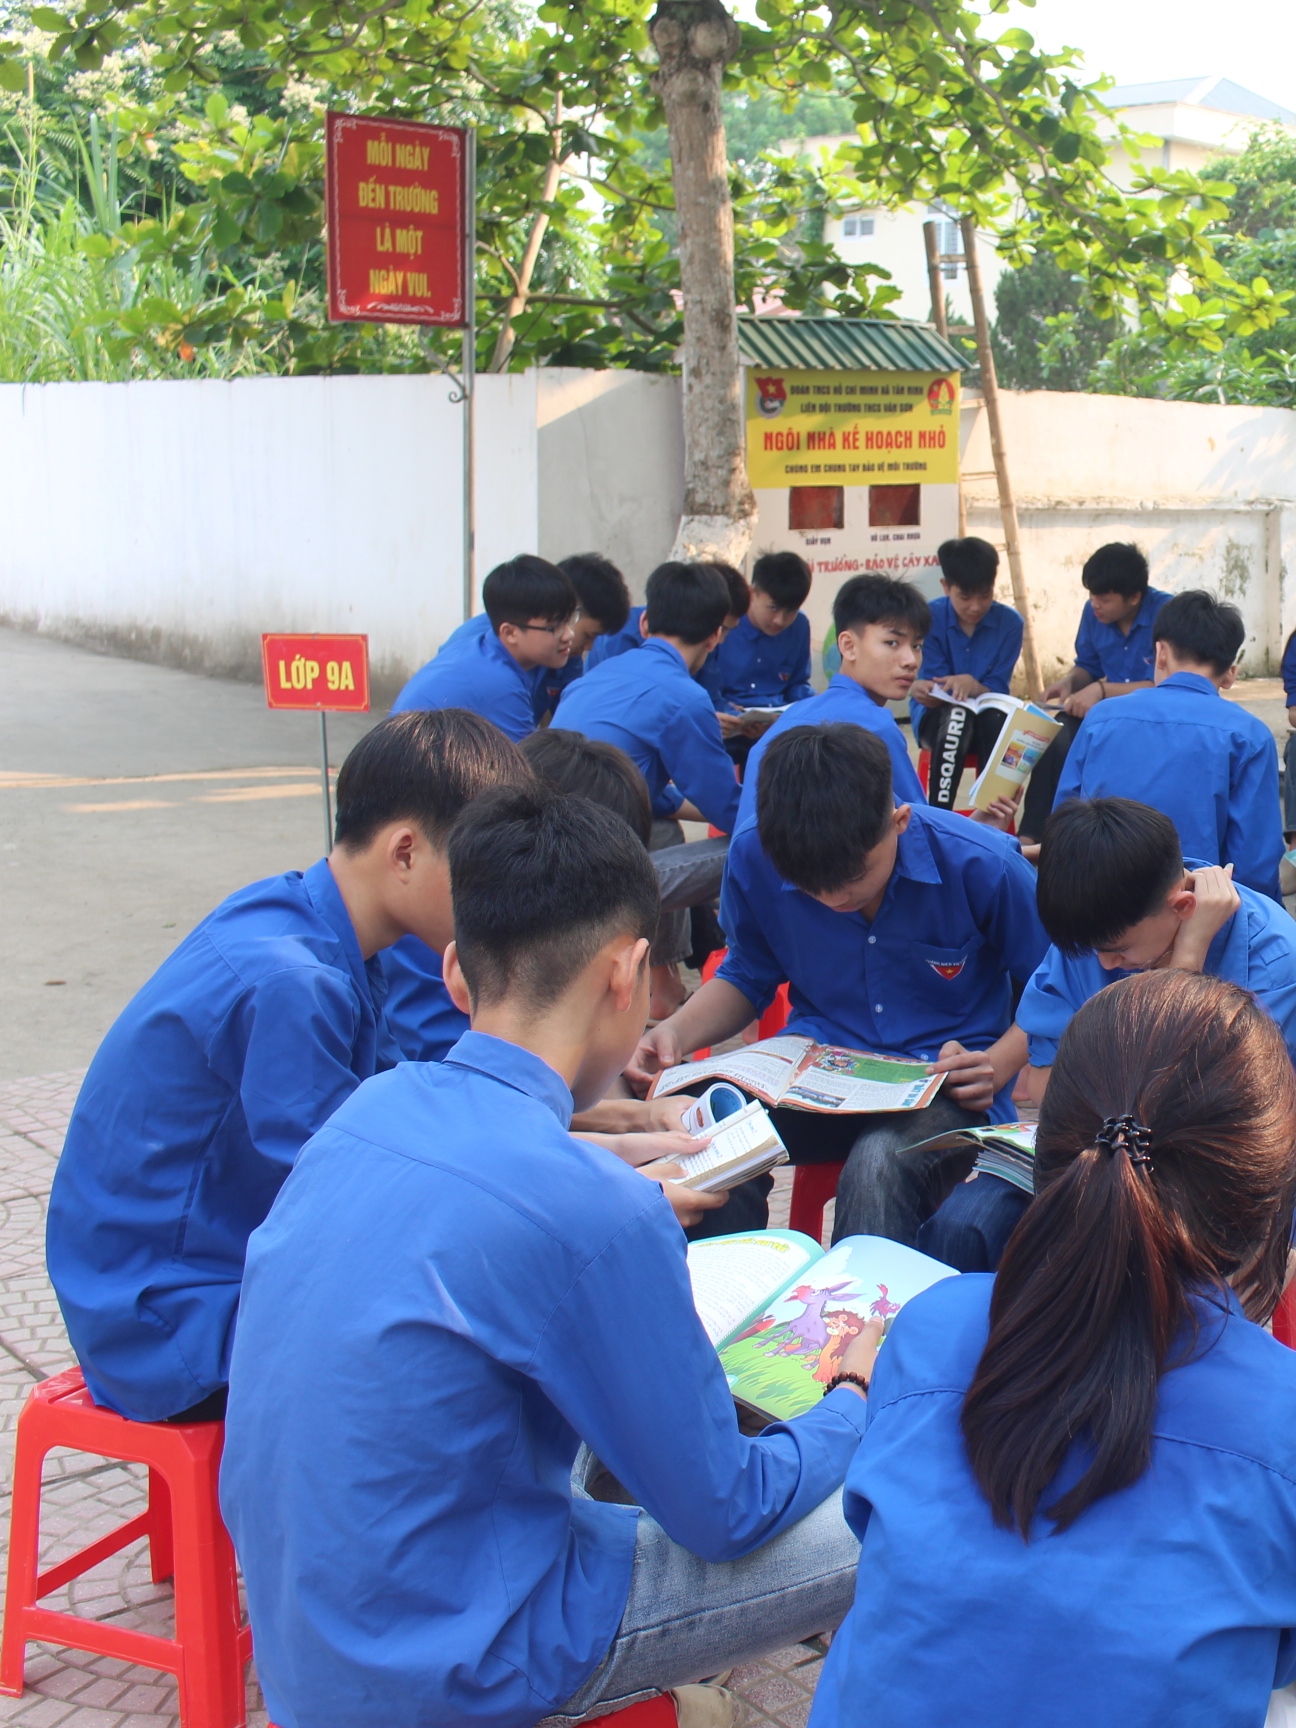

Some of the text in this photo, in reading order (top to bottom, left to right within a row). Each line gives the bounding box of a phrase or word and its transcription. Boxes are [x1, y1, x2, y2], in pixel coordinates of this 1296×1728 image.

[367, 132, 430, 171] MỖI NGÀY
[359, 175, 439, 215] ĐẾN TRƯỜNG
[376, 222, 424, 259] LÀ MỘT
[369, 265, 431, 298] NGÀY VUI.
[764, 424, 946, 453] NGÔI NHÀ KẾ HOẠCH NHỎ
[811, 463, 822, 473] EM
[865, 553, 885, 571] BẢO
[886, 554, 900, 572] VỆ
[902, 553, 921, 568] CÂY
[923, 555, 941, 568] XA
[279, 654, 355, 691] LỚP 9A
[937, 706, 966, 803] DSQAURD
